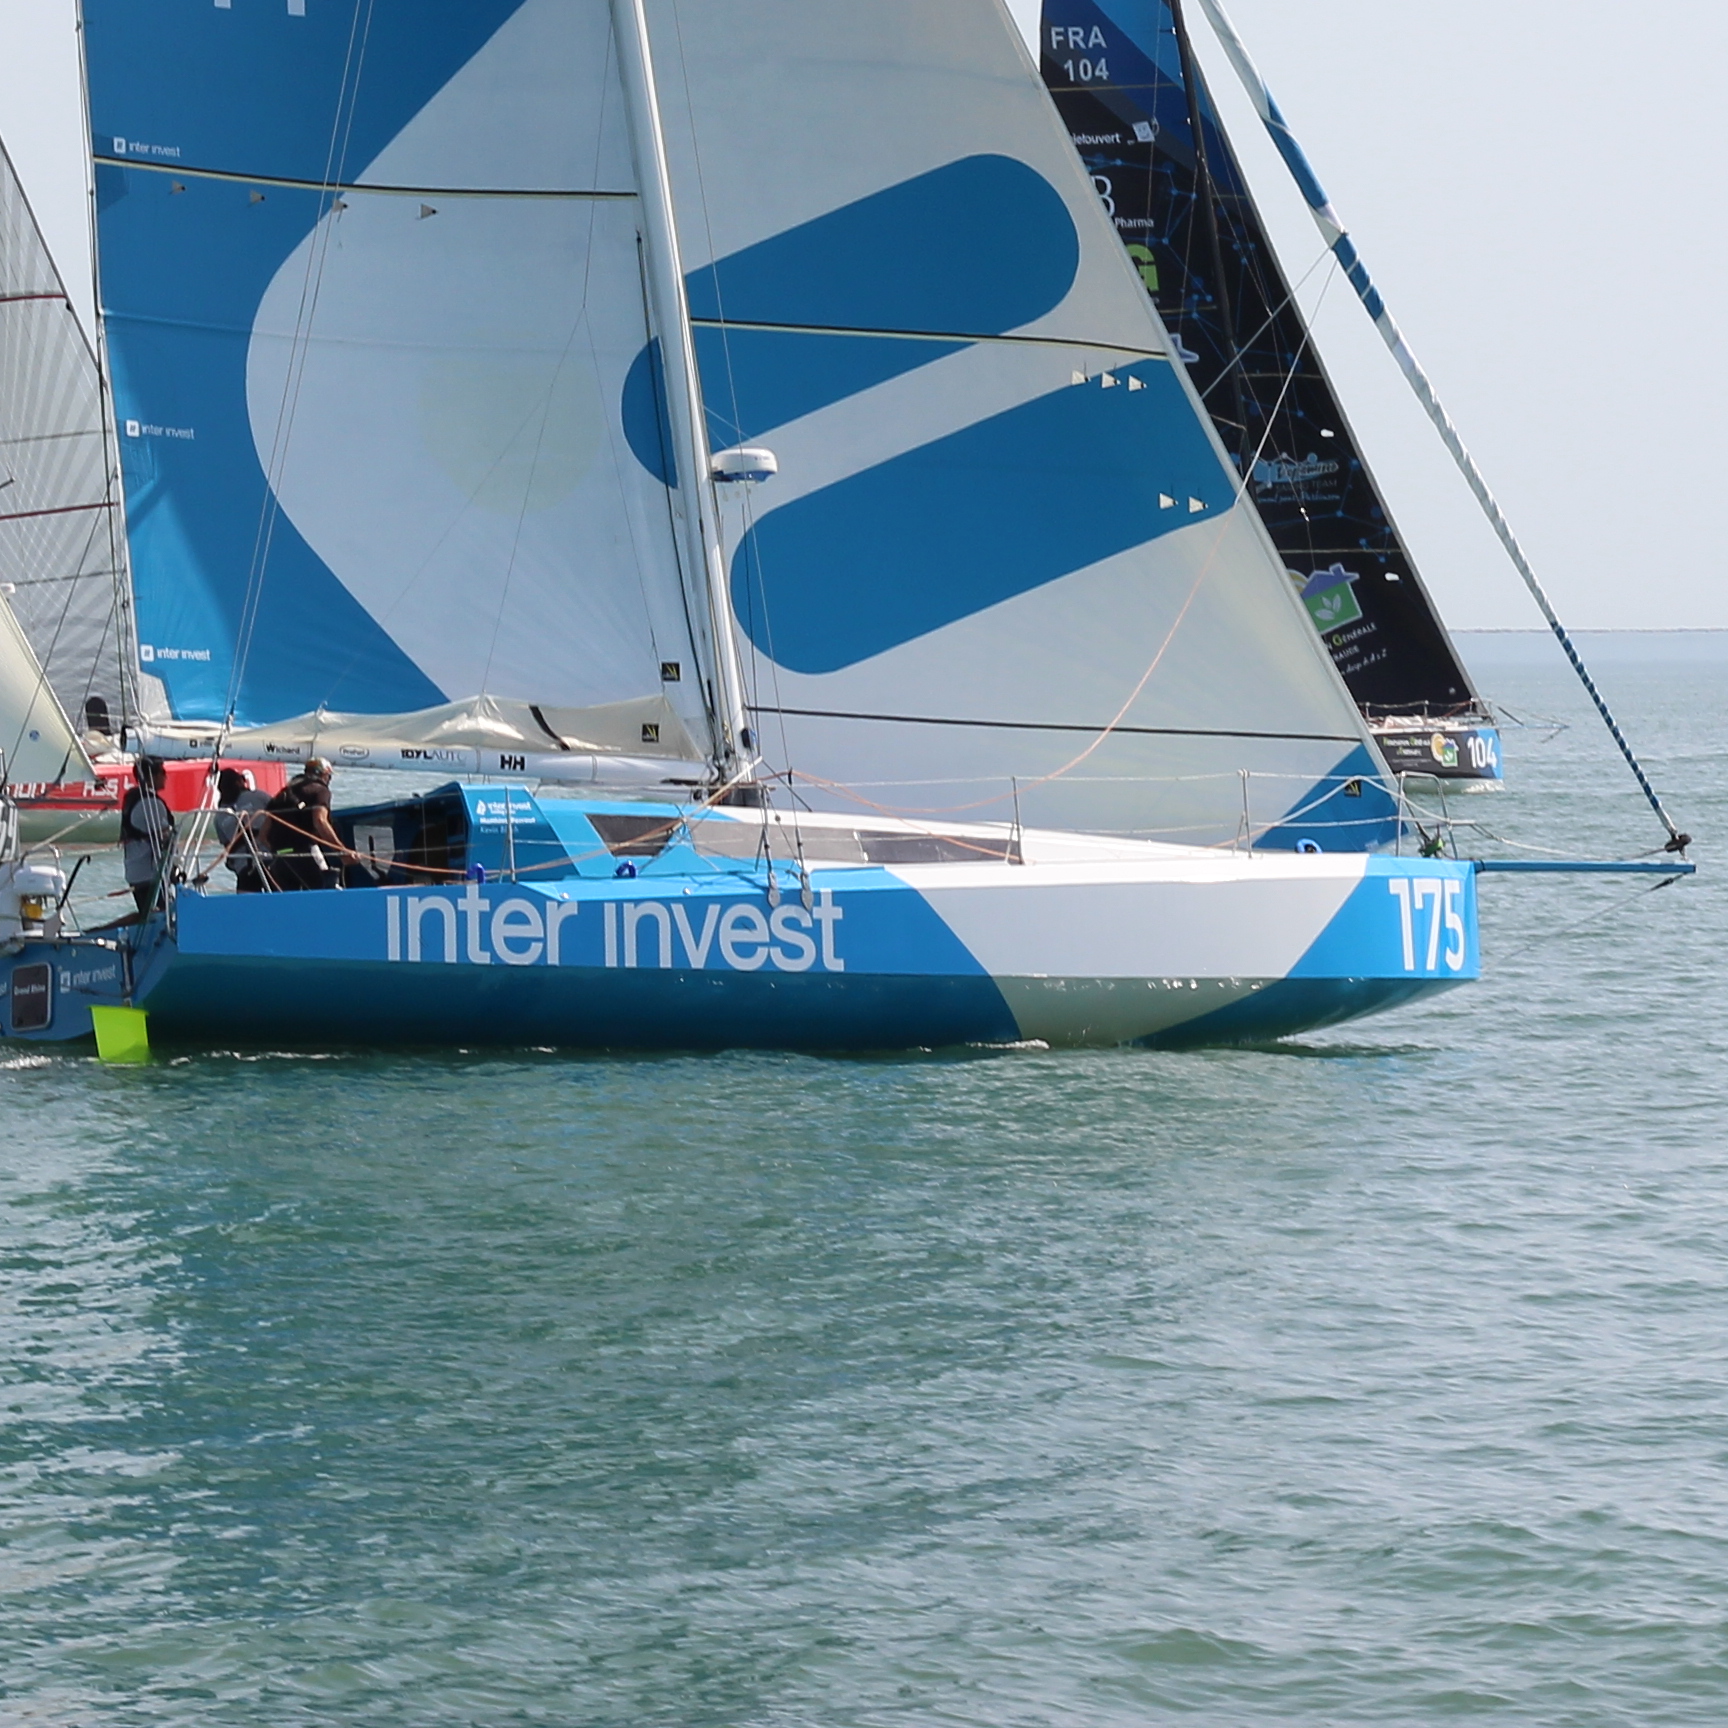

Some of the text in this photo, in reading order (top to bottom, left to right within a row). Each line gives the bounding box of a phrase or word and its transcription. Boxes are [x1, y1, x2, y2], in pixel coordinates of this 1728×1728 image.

[1050, 25, 1108, 50] FRA
[1063, 56, 1110, 82] 104
[1115, 217, 1155, 228] Pharma
[500, 754, 525, 771] HH
[1467, 736, 1497, 769] 104
[386, 884, 845, 972] inter invest
[1388, 878, 1465, 972] 175
